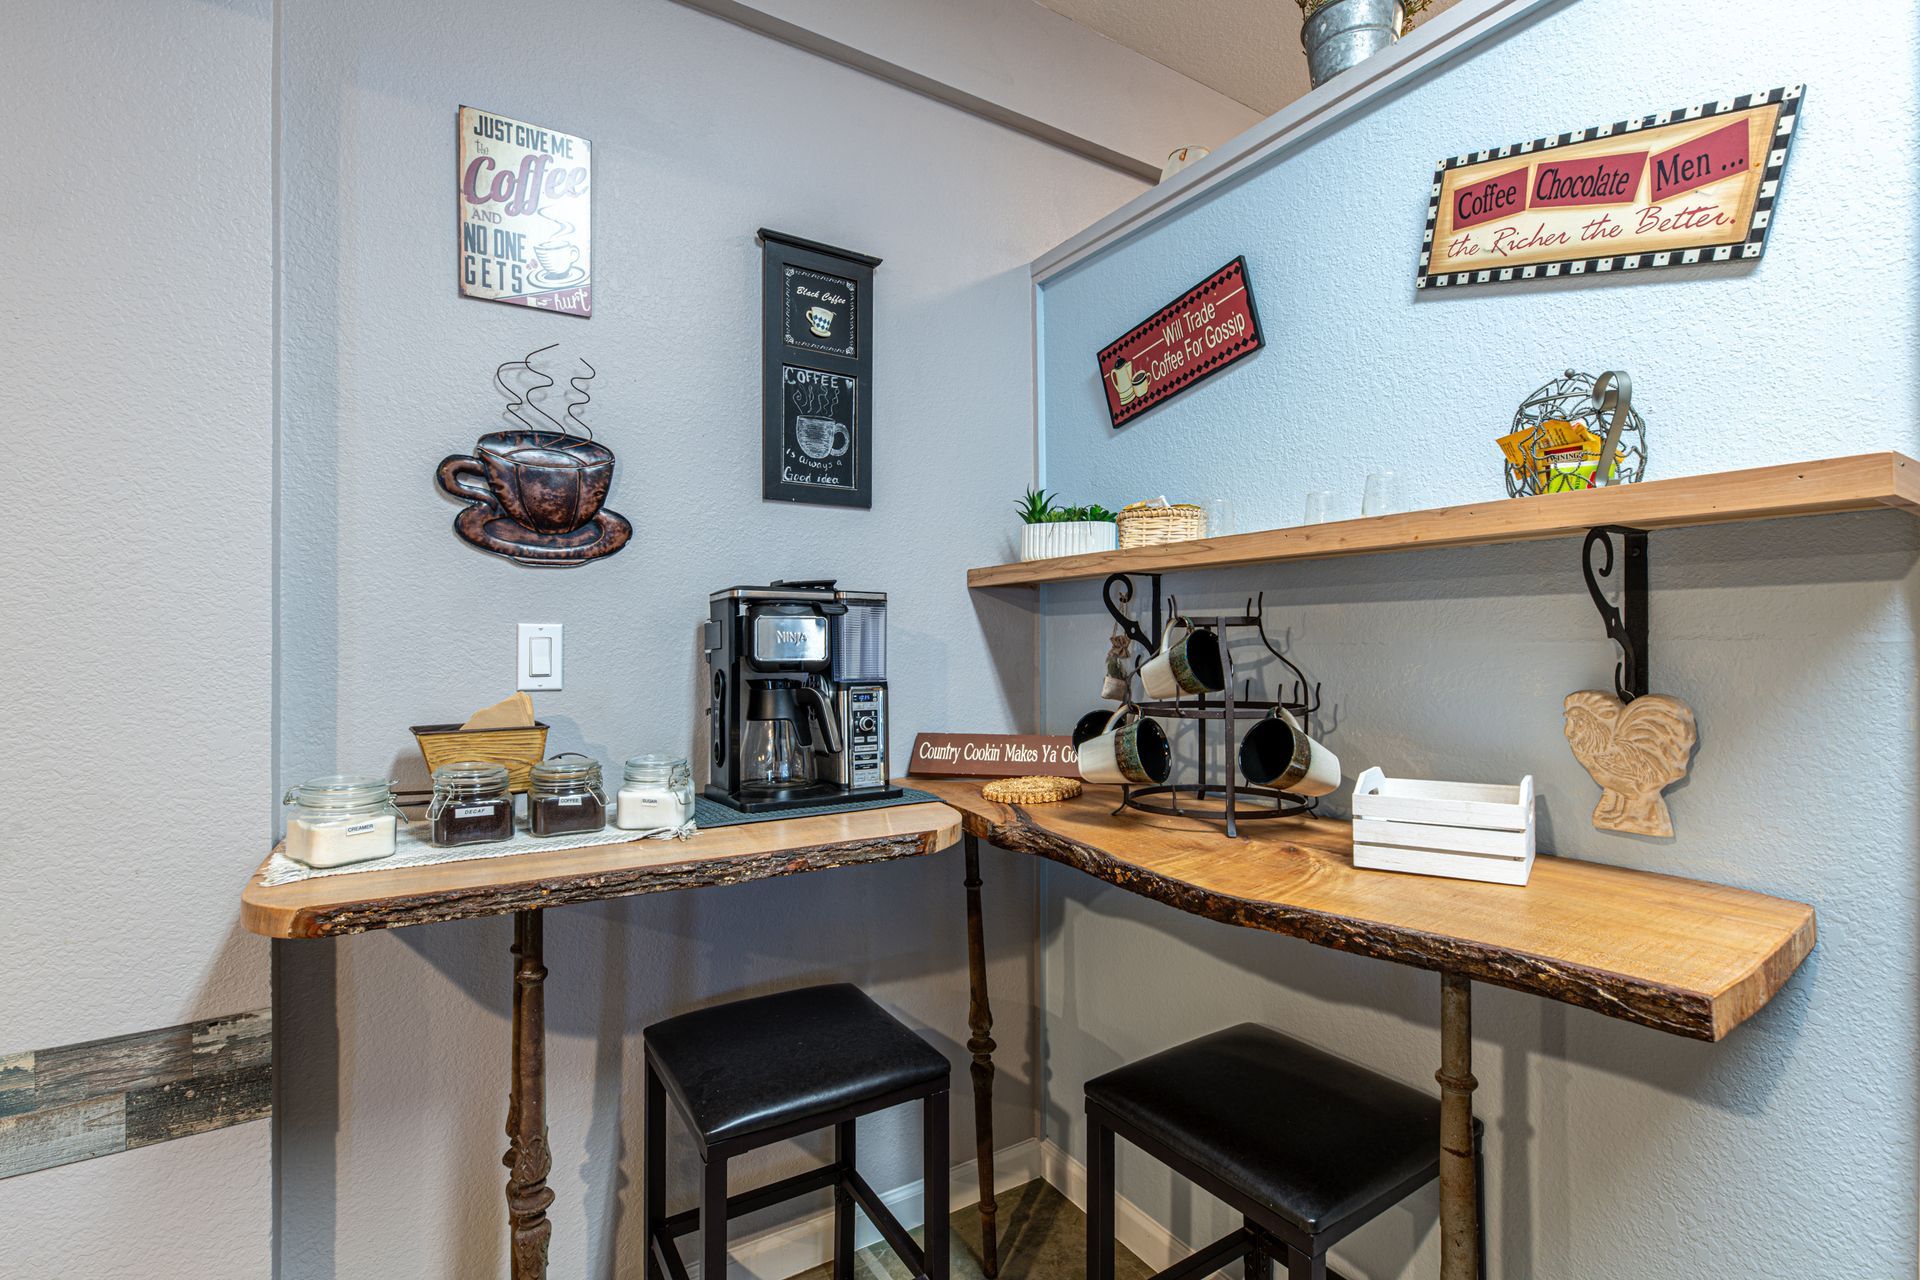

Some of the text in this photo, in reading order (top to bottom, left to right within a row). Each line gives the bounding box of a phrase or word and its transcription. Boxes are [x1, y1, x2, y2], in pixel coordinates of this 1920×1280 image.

[474, 115, 573, 160] JUST GIVE ME
[462, 154, 589, 216] Coffee
[1457, 181, 1517, 220] Coffee
[1535, 166, 1630, 202] Chocolate
[1656, 152, 1711, 192] Men
[471, 207, 502, 224] AND
[464, 222, 527, 263] NO ONE
[1447, 204, 1736, 259] the Richer the Better.
[464, 256, 523, 294] GETS
[554, 288, 591, 312] hurt
[796, 286, 847, 305] Black Coffee
[1162, 302, 1216, 347] Will Trade
[1151, 311, 1245, 381] Coffee For Gossip
[784, 367, 839, 389] COFFEE
[784, 466, 839, 484] Good idea
[776, 630, 808, 646] NINJA
[919, 741, 961, 764] Country
[964, 742, 1003, 762] Cookin'
[1004, 743, 1038, 763] Makes
[347, 823, 374, 833] CREAMER
